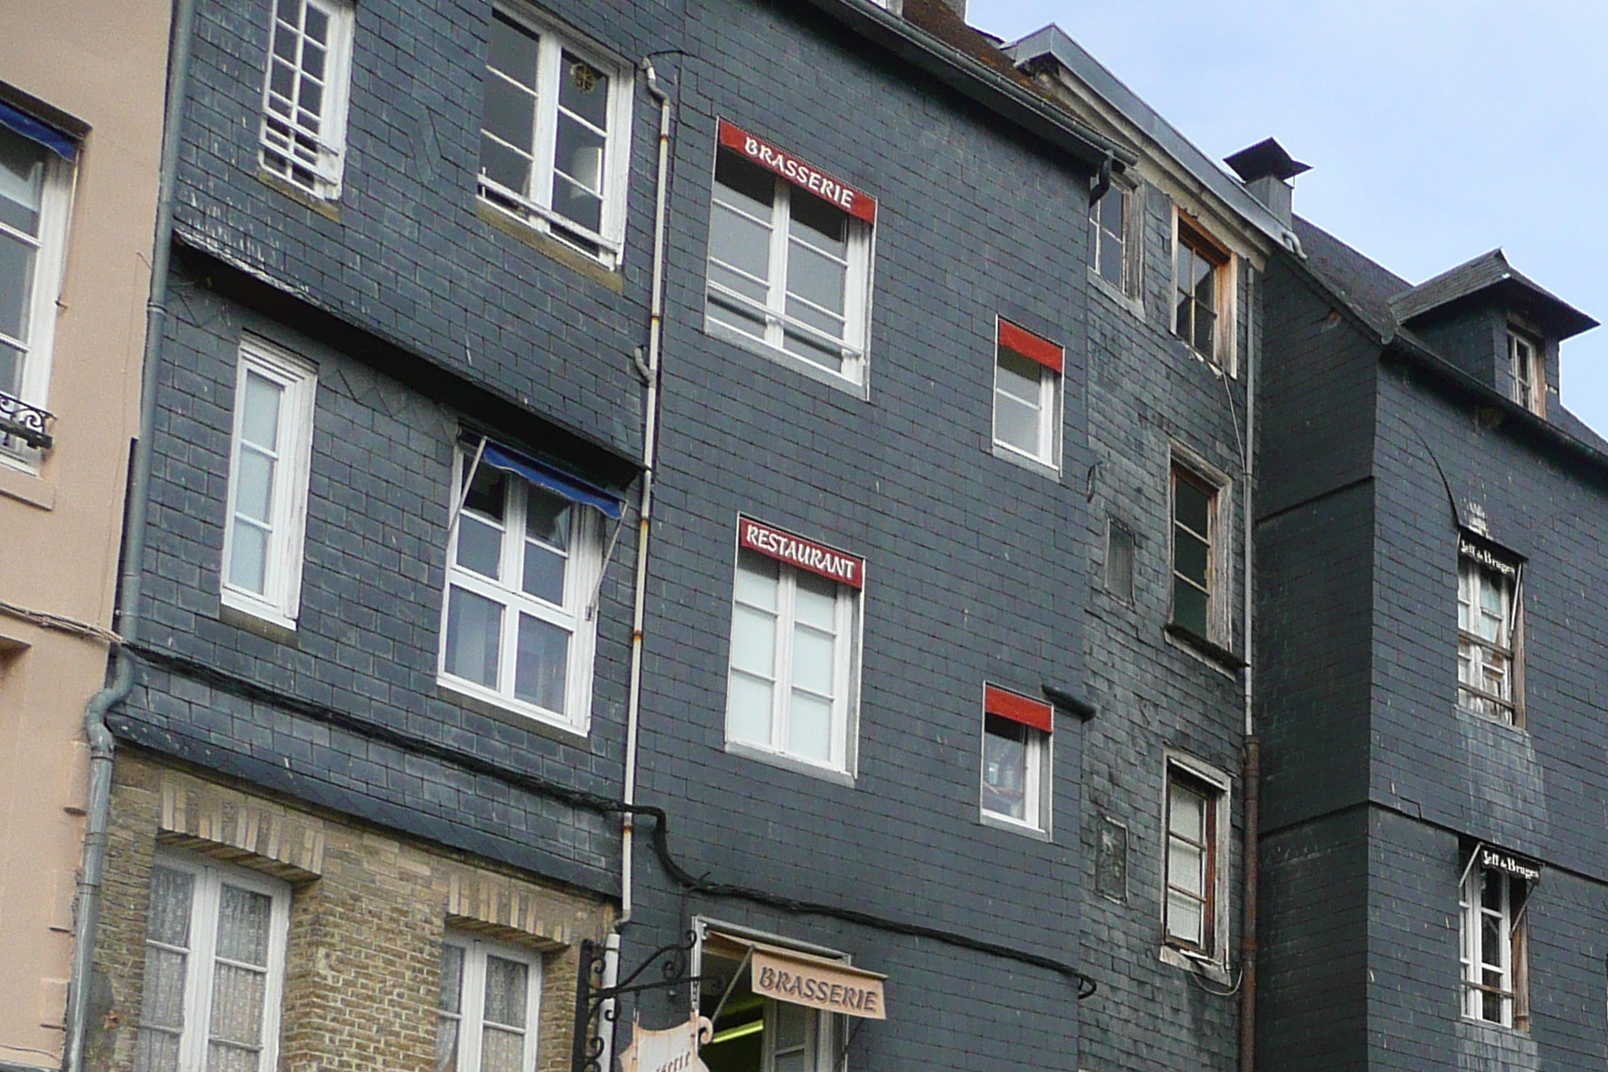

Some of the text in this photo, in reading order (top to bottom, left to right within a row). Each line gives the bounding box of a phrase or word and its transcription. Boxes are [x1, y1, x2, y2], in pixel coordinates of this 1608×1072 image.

[744, 136, 855, 209] BRASSERIE
[746, 524, 855, 579] RESTAURANT
[1483, 850, 1499, 867] Jeff
[1507, 856, 1539, 880] Bruges
[759, 965, 877, 1013] BRASSERIE
